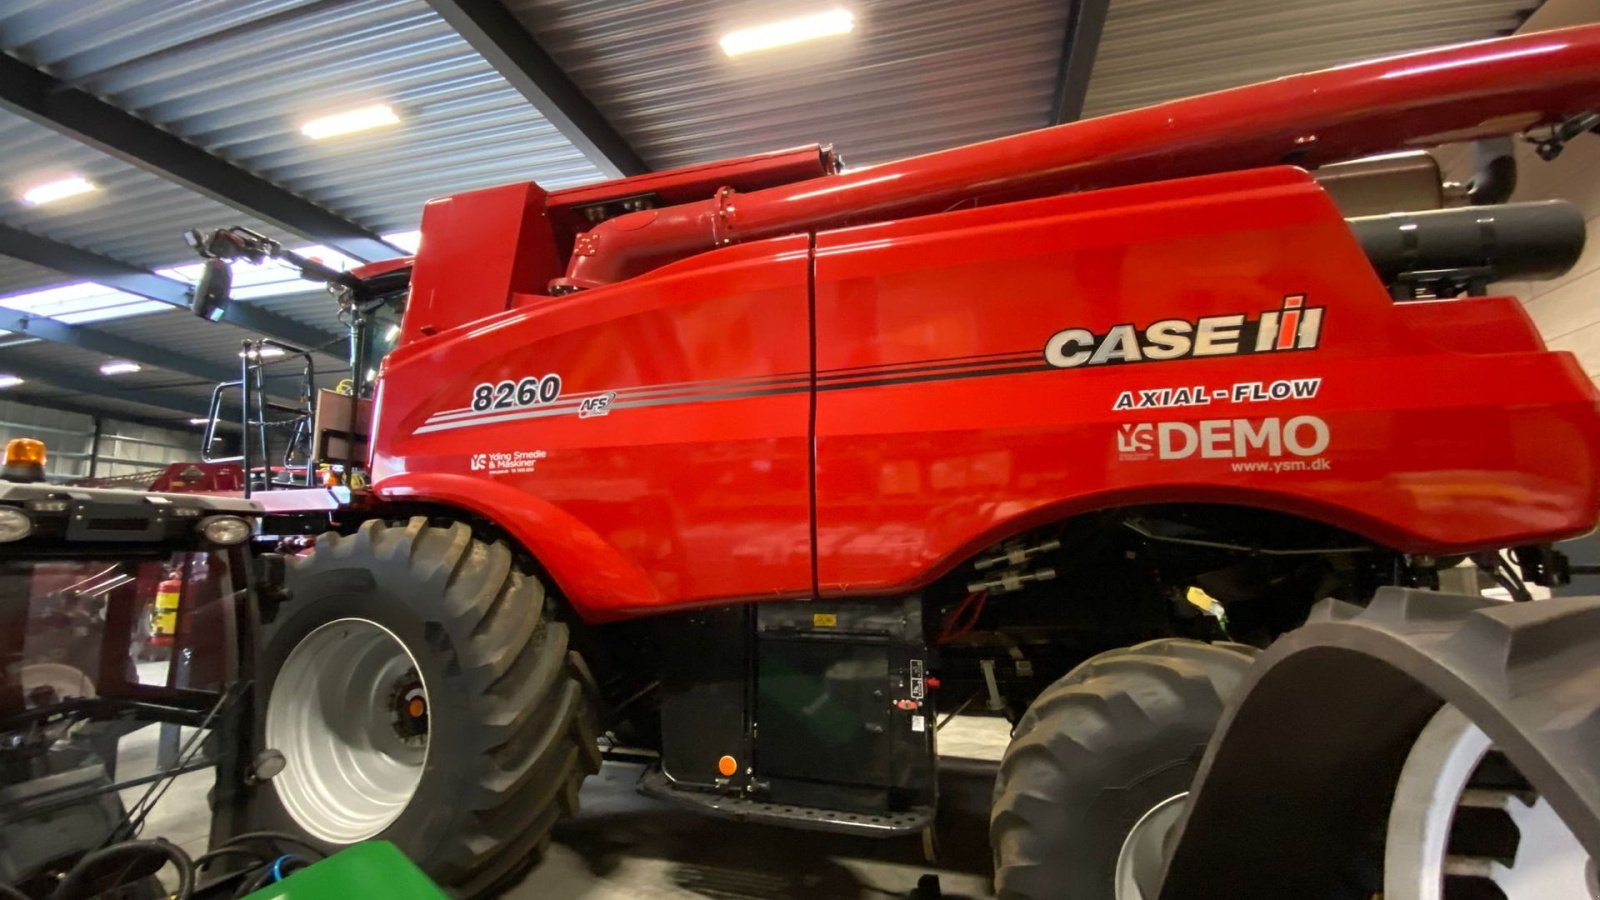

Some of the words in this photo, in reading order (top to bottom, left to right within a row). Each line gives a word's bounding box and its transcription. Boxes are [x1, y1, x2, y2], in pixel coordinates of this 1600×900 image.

[1045, 314, 1245, 368] CASE
[473, 373, 562, 412] 8260
[1113, 378, 1322, 410] AXIAL-FLOW
[580, 397, 608, 411] AFS
[1117, 423, 1154, 452] YS
[1159, 415, 1331, 460] DEMO
[471, 454, 487, 470] YS
[489, 453, 512, 462] Yding
[513, 450, 547, 459] Smedie
[489, 461, 496, 469] &
[498, 460, 536, 468] Maskiner
[1232, 460, 1331, 473] www.ysm.dk
